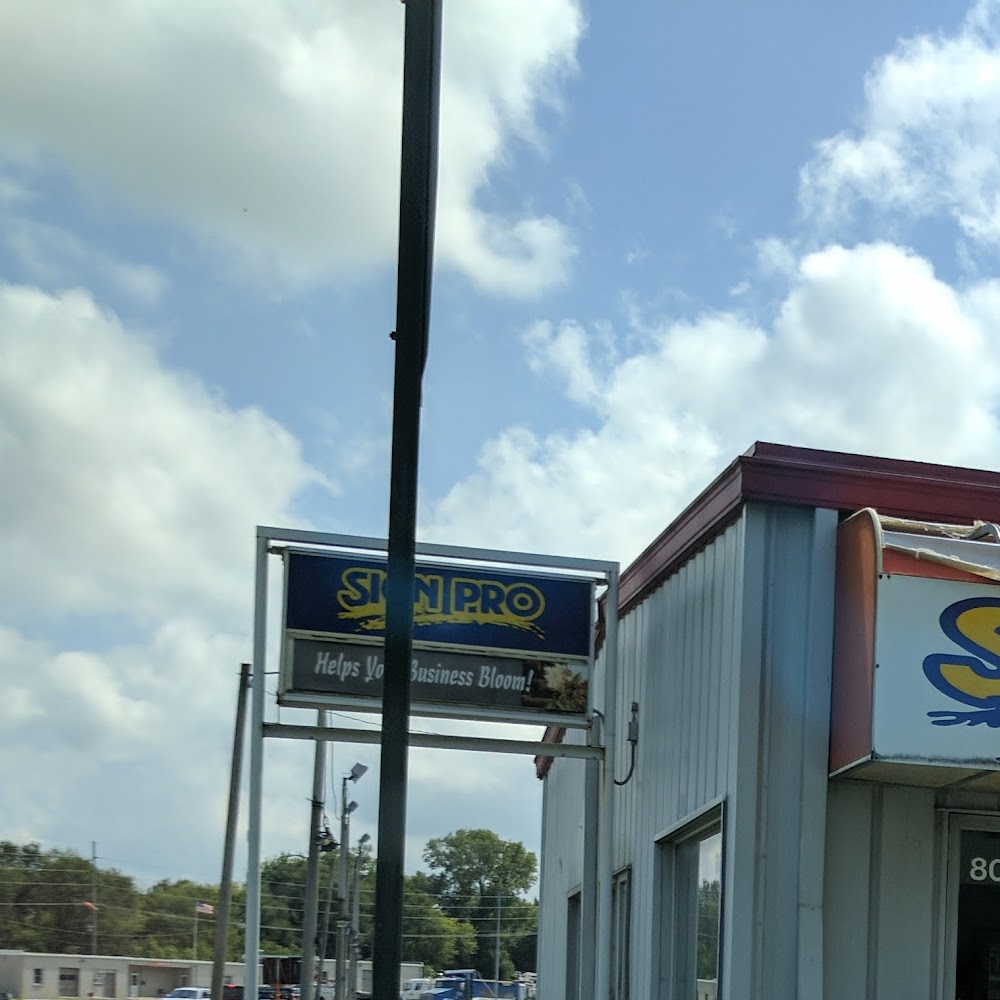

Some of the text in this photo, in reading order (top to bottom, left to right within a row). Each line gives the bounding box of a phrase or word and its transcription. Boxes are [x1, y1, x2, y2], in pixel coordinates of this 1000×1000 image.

[336, 566, 546, 622] SIN PRO
[313, 651, 361, 682] Helps
[477, 664, 534, 693] Bloom!
